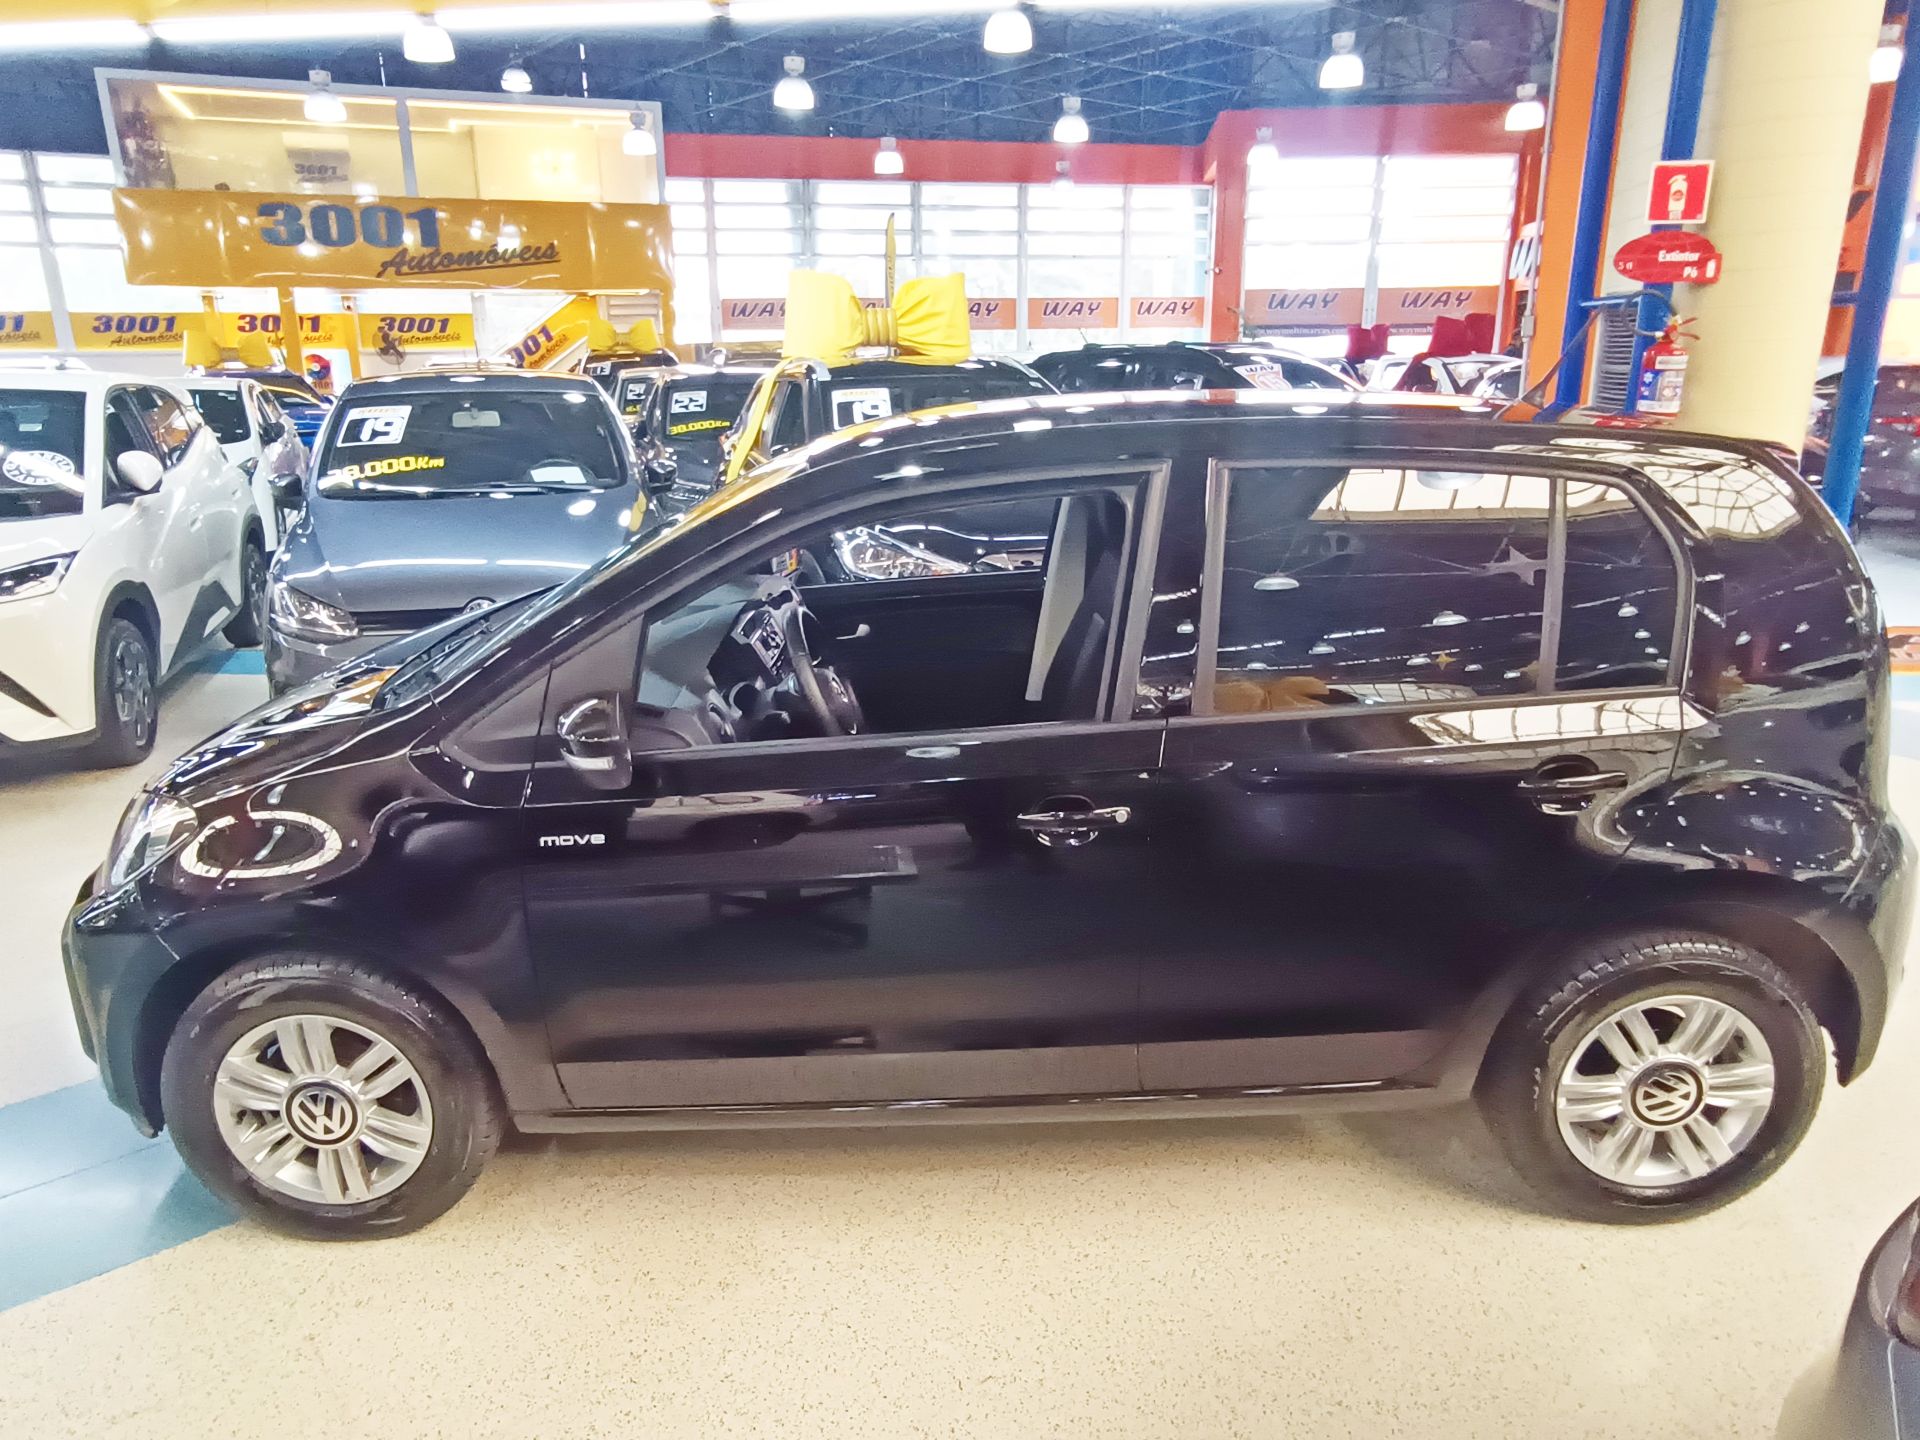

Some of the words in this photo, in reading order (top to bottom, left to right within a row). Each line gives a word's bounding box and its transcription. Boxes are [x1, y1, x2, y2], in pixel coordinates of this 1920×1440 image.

[257, 202, 441, 248] 3001
[376, 242, 560, 278] Automóveis
[1137, 301, 1195, 316] WAY
[1267, 292, 1340, 310] WAY
[1401, 290, 1474, 309] WAY
[969, 302, 999, 317] AY
[1043, 301, 1102, 317] WAY
[92, 315, 177, 333] 3001
[237, 314, 321, 333] 301
[378, 317, 450, 334] 3001
[674, 397, 706, 411] 22
[852, 400, 890, 424] 19
[360, 417, 405, 442] 19
[539, 833, 606, 847] move
